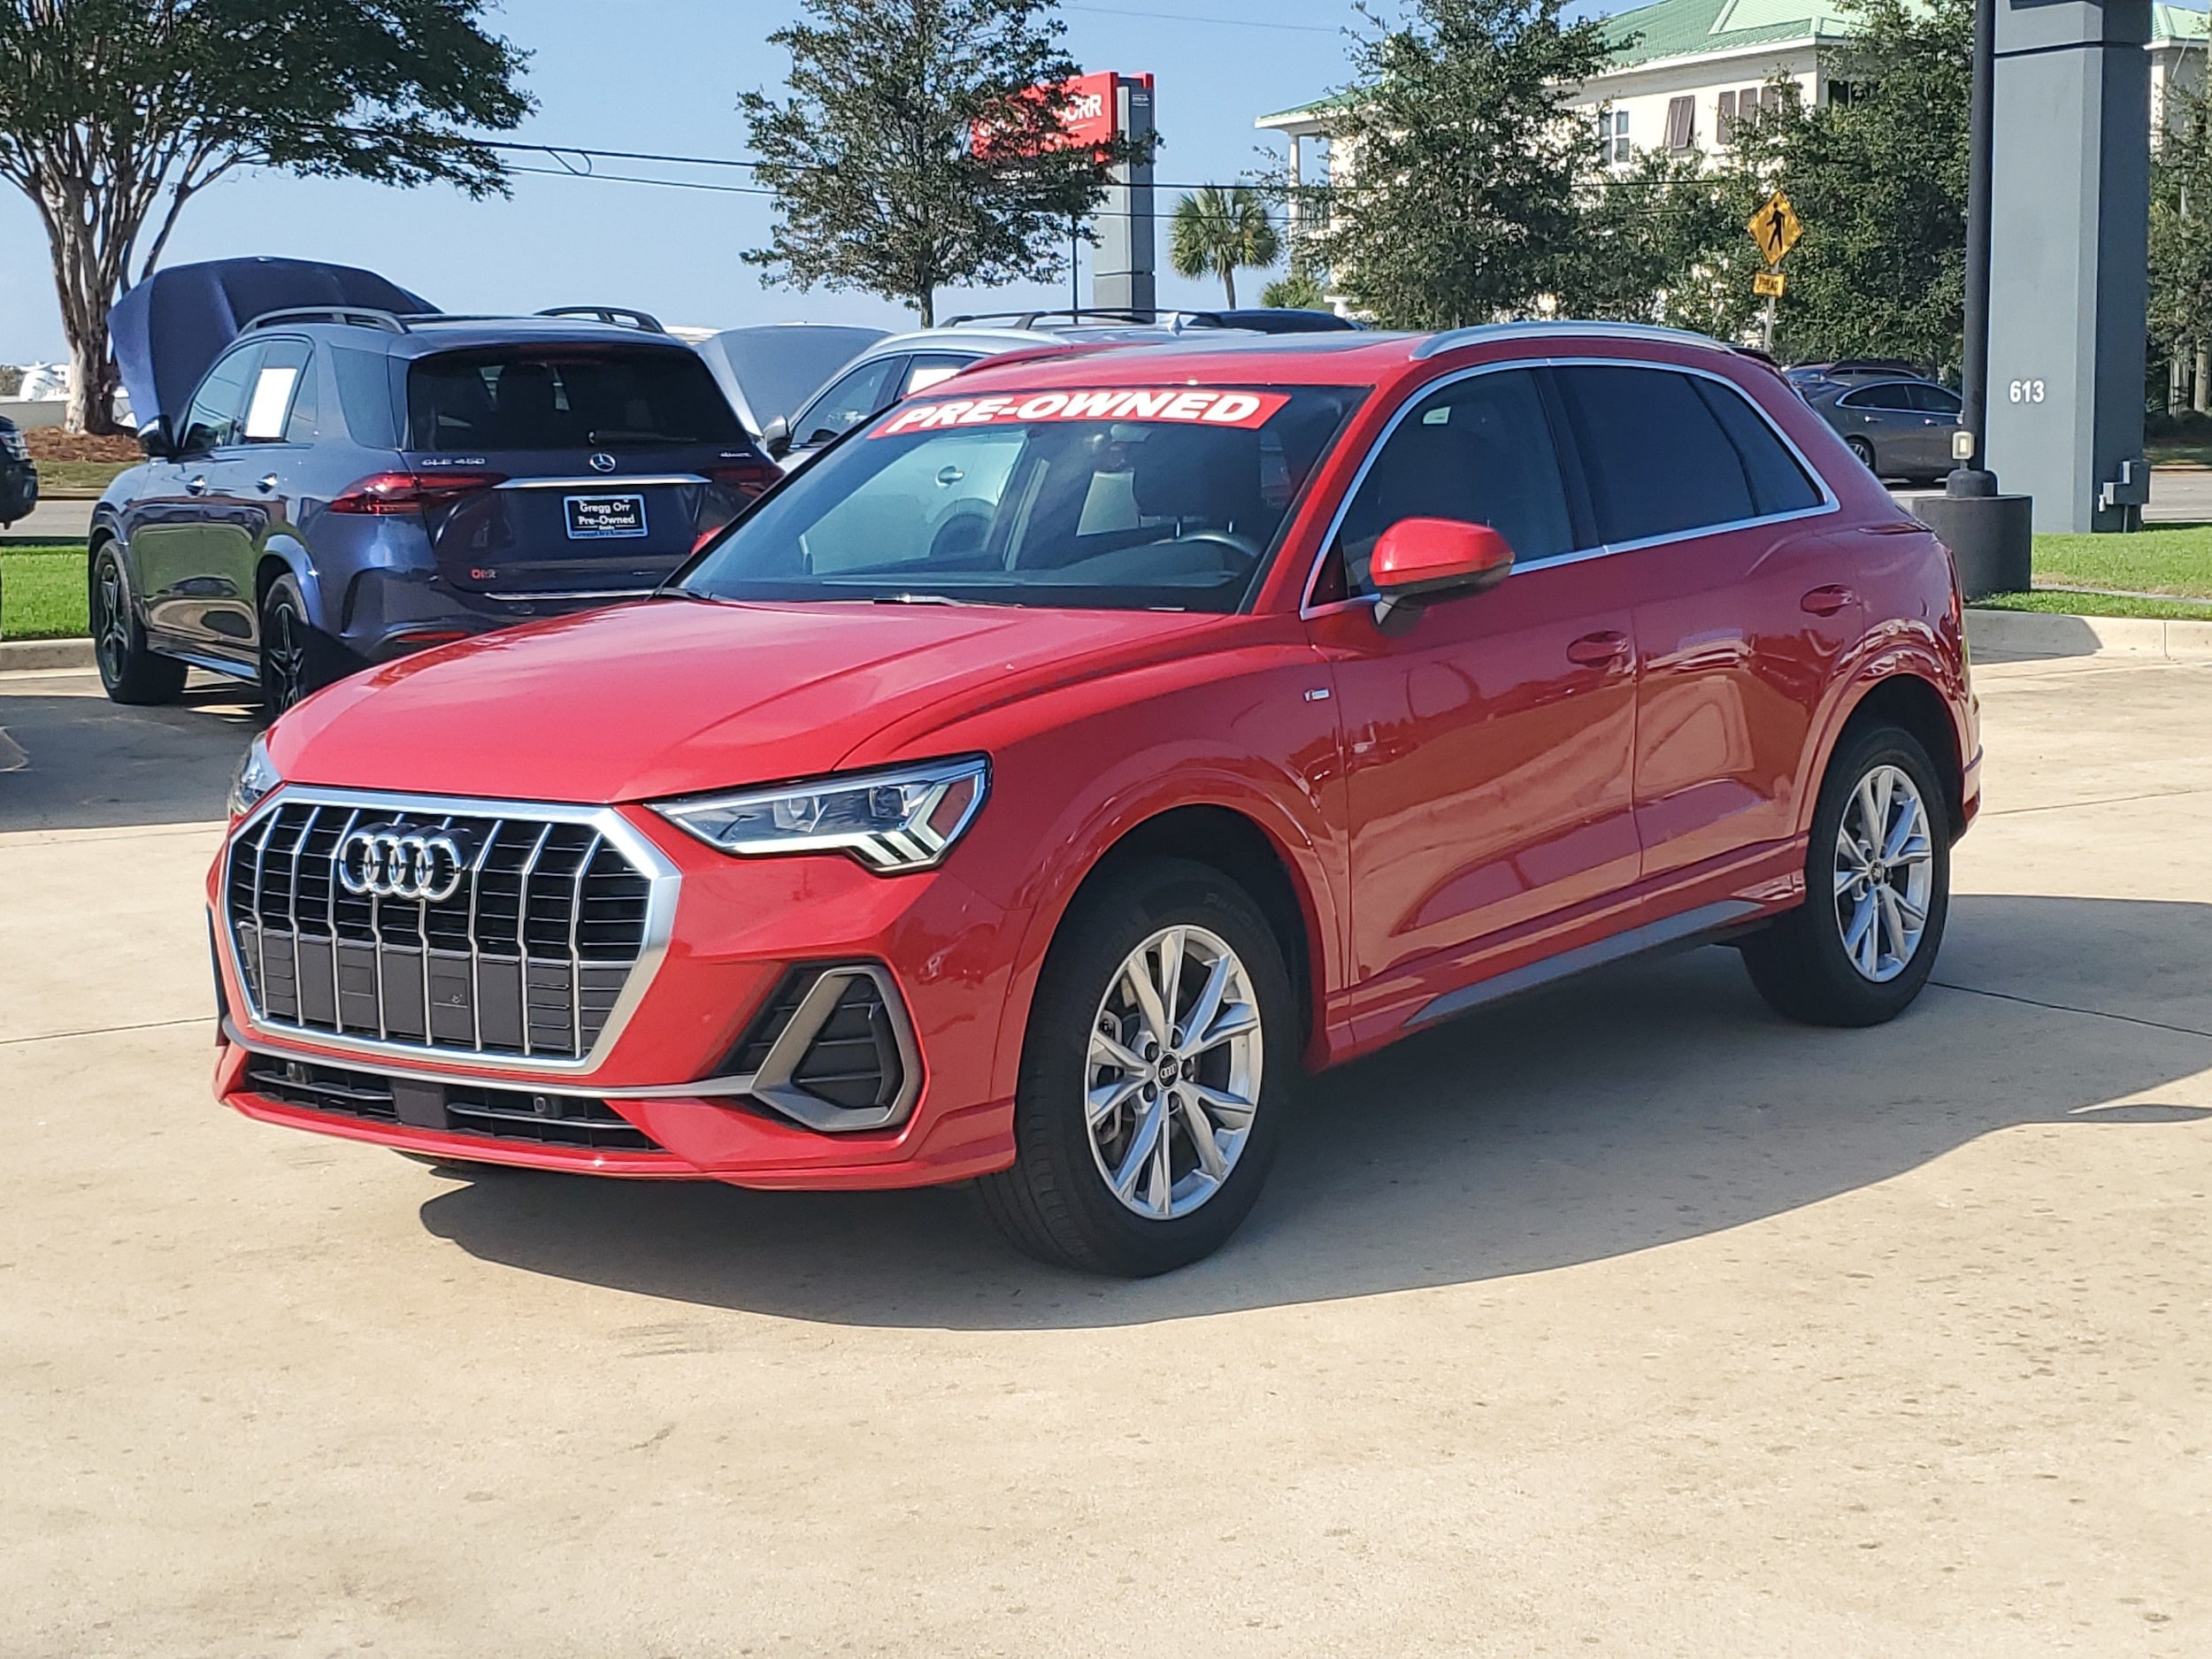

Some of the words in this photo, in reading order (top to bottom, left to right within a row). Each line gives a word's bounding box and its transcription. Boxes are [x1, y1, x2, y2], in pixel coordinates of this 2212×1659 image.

[2009, 380, 2045, 403] 613
[886, 392, 1261, 434] PRE-OWNED
[580, 501, 611, 514] Gregg
[612, 502, 631, 512] Orr
[578, 513, 636, 525] Pre-Owned
